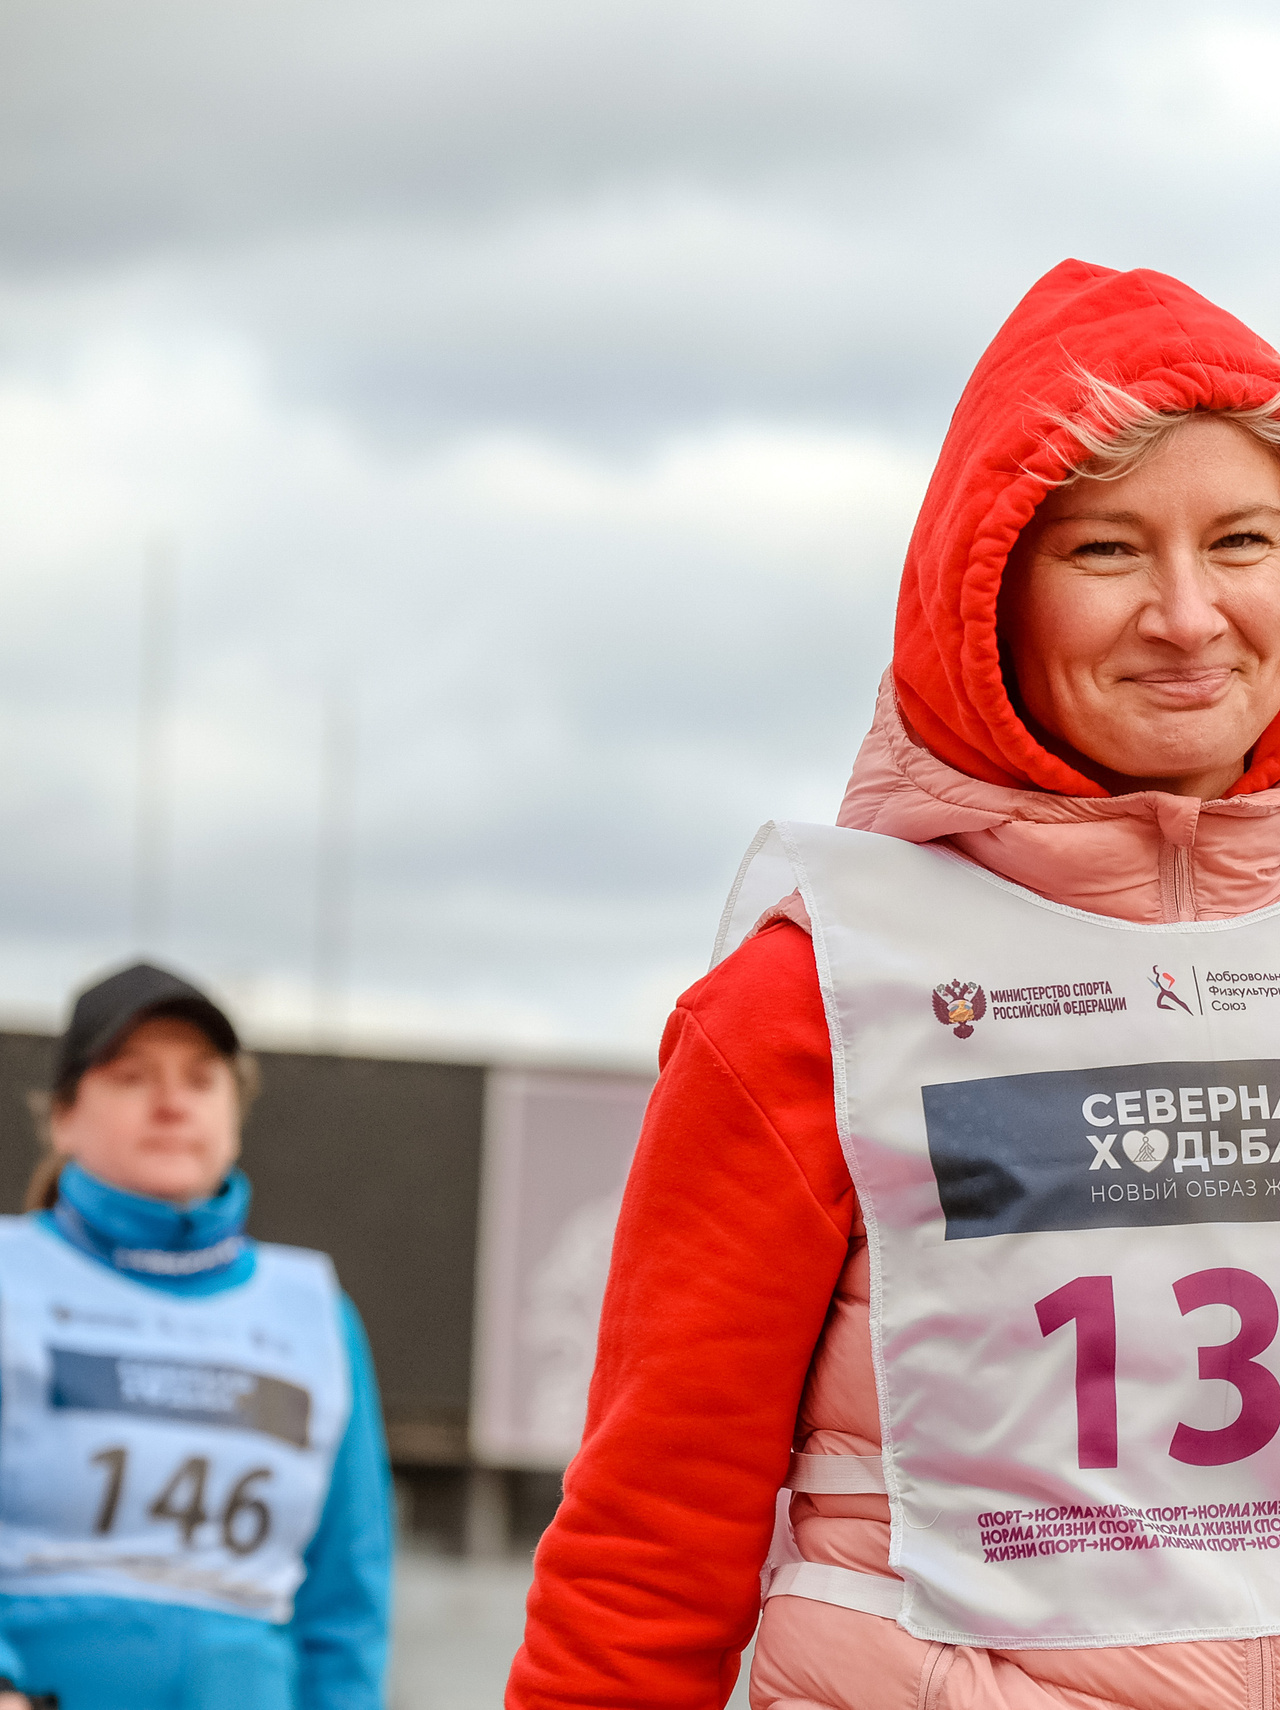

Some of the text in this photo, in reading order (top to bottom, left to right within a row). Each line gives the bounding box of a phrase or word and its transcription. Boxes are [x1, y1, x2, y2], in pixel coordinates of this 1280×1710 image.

[990, 981, 1112, 1003] МИНИСТЕРСТВО СПОРТА
[993, 997, 1127, 1020] РОССИЙСКОЙ ФЕДЕРАЦИИ
[1211, 1000, 1247, 1011] Союз
[1090, 1178, 1178, 1203] НОВЫЙ
[1186, 1179, 1257, 1198] ОБРАЗ
[88, 1446, 276, 1557] 146
[980, 1525, 1034, 1546] НОРМА
[1036, 1521, 1096, 1539] ЖИЗНИ
[1201, 1520, 1252, 1537] ЖИЗНИ
[983, 1544, 1037, 1563] ЖИЗНИ
